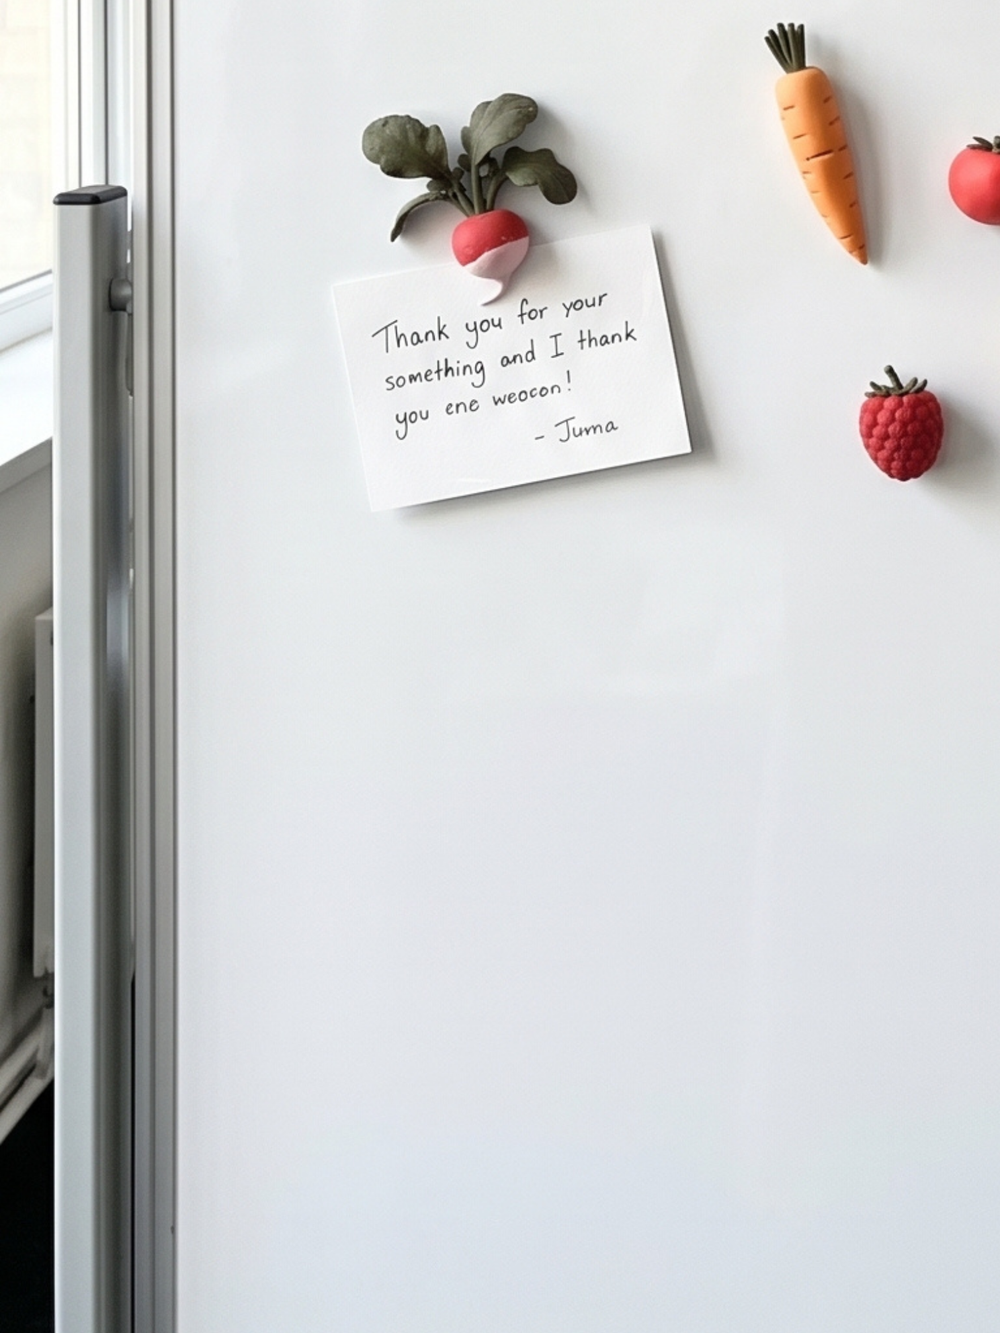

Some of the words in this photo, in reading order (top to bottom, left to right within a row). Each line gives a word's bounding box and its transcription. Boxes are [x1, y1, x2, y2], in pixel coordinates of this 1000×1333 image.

[372, 316, 449, 353] Thank
[465, 317, 502, 349] you
[517, 298, 548, 324] for
[562, 293, 608, 317] your
[385, 358, 486, 391] something
[500, 339, 536, 368] and
[550, 332, 564, 359] I
[577, 321, 637, 351] thank
[395, 407, 429, 440] you
